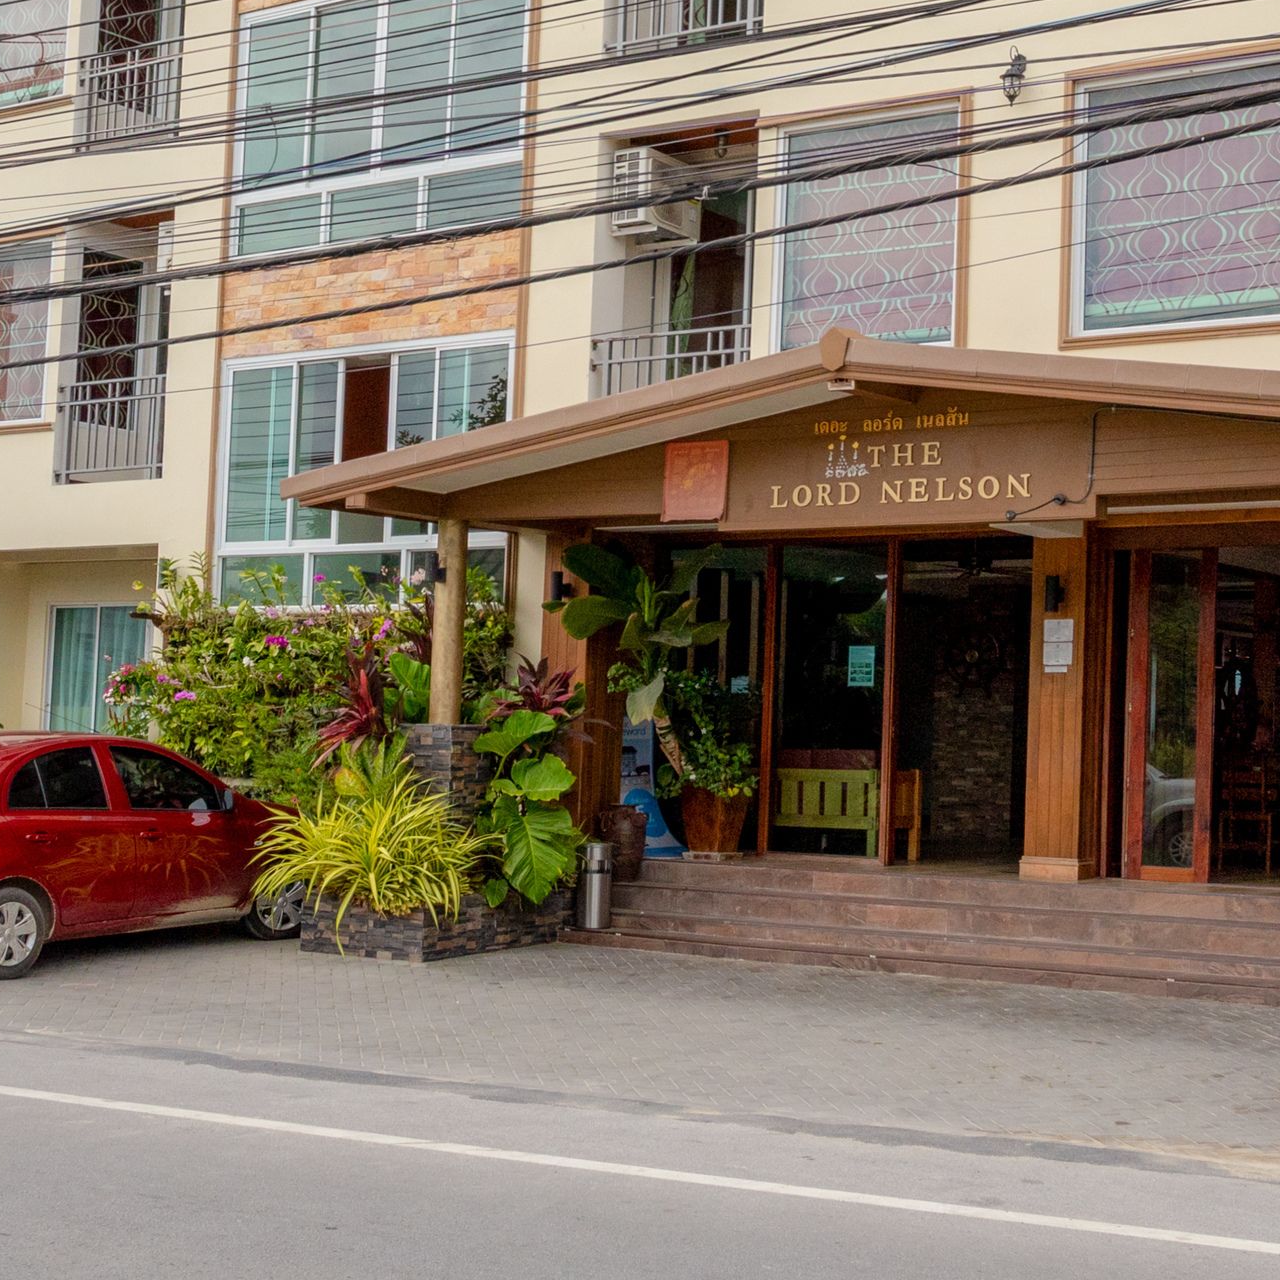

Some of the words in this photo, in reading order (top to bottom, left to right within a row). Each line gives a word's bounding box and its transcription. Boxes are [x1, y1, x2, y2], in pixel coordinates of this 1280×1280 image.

[814, 420, 848, 435] เดอะ
[863, 409, 903, 433] ลอร์ด
[916, 407, 970, 429] เนลสัน
[867, 441, 943, 468] THE
[770, 481, 862, 509] LORD
[879, 473, 1033, 505] NELSON
